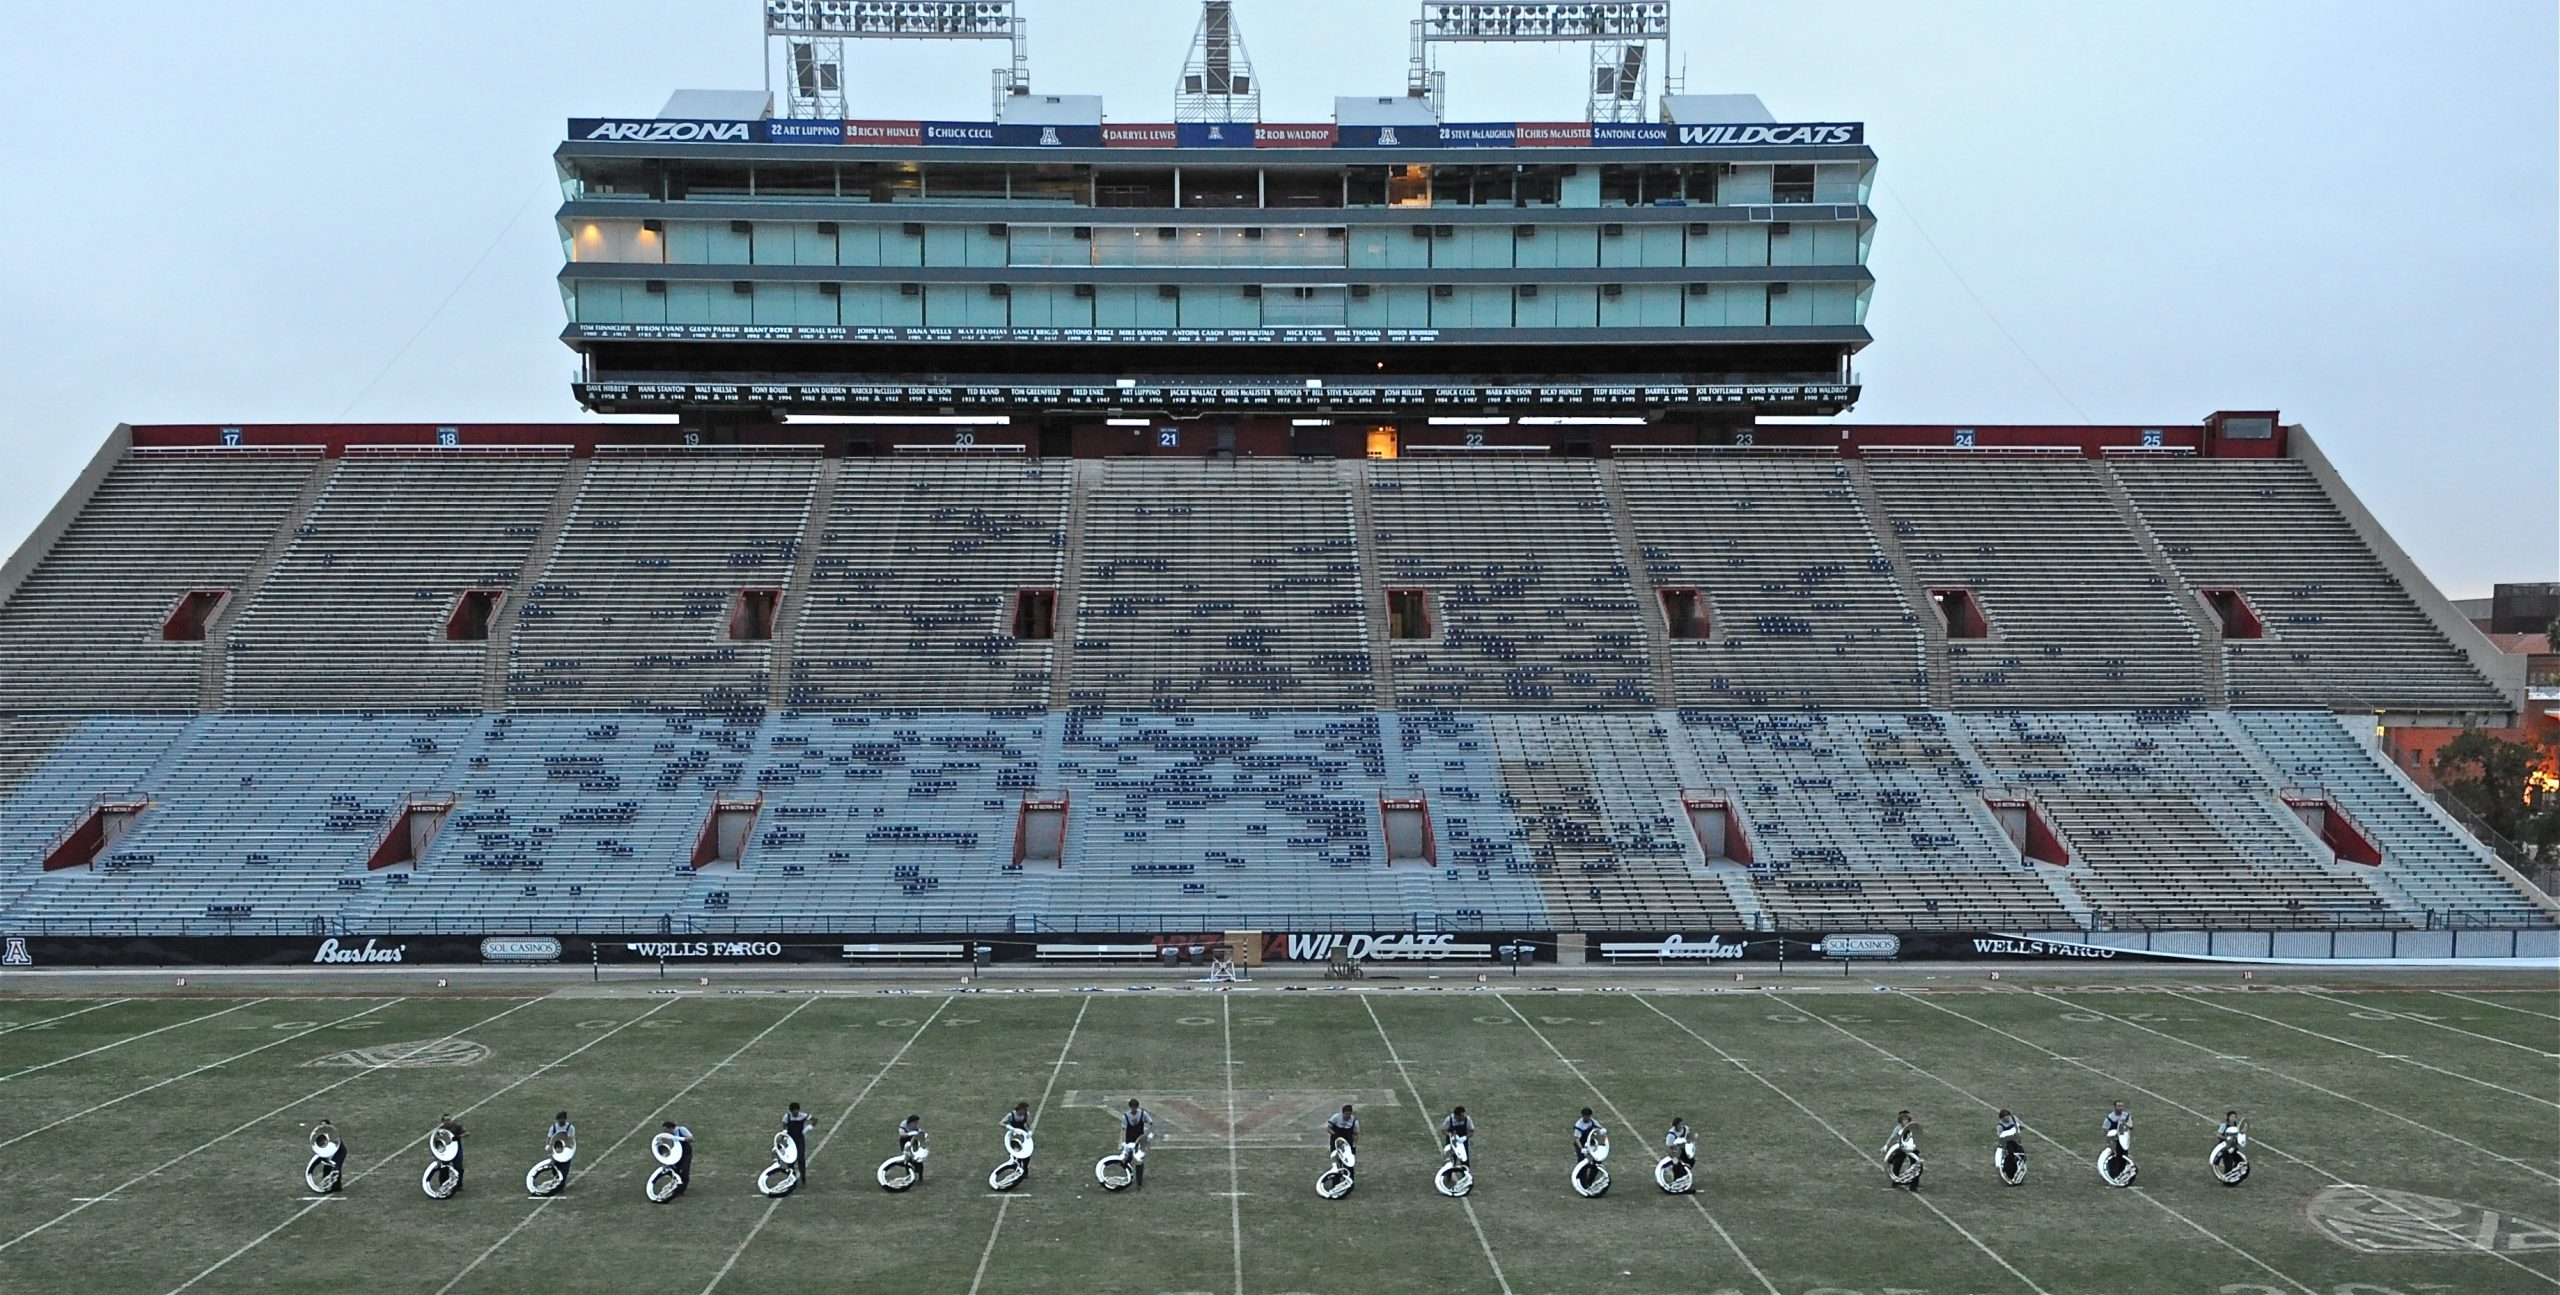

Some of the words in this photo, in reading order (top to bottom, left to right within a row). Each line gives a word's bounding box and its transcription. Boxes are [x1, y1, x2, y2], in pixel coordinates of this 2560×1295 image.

[586, 122, 750, 140] ARIZONA
[772, 124, 782, 135] 22
[783, 126, 800, 136] ART
[802, 126, 840, 136] LUPPINO
[858, 128, 884, 136] RICKY
[886, 128, 921, 137] HUNLEY
[928, 127, 935, 138] 6
[935, 128, 967, 138] CHUCK
[968, 129, 993, 138] CECIL
[1102, 129, 1108, 140] 4
[1110, 130, 1148, 140] DARRYLL
[1150, 130, 1176, 140] LEWIS
[1255, 129, 1266, 140] 92
[1267, 130, 1285, 140] ROB
[1286, 130, 1329, 140] WALDROP
[1440, 128, 1450, 139] 28
[1451, 130, 1470, 139] STEVE
[1471, 130, 1515, 139] McLAUGHLIN
[1516, 128, 1524, 138] 11
[1524, 130, 1548, 138] CHRIS
[1550, 130, 1592, 138] McALISTER
[1594, 128, 1600, 139] 5
[1600, 130, 1636, 139] ANTOINE
[1638, 130, 1667, 139] CASON
[1679, 126, 1853, 145] WILDCATS
[224, 434, 239, 446] 17
[440, 433, 456, 446] 18
[684, 433, 699, 446] 19
[956, 434, 974, 446] 20
[1161, 433, 1176, 446] 21
[1466, 434, 1483, 446] 22
[1736, 434, 1753, 446] 23
[1956, 434, 1973, 448] 24
[2144, 436, 2161, 448] 25
[313, 938, 406, 963] Bashas'
[490, 944, 506, 954] SOL
[510, 944, 554, 954] CASINOS
[636, 942, 708, 956] WELLS
[712, 942, 781, 956] FARGO
[1288, 934, 1454, 960] WILDCATS
[1830, 940, 1848, 950] SOL
[1850, 940, 1892, 950] CASINOS
[1972, 939, 2043, 954] WELLS
[2244, 971, 2252, 979] 10
[176, 978, 185, 986] 10
[438, 978, 446, 987] 20
